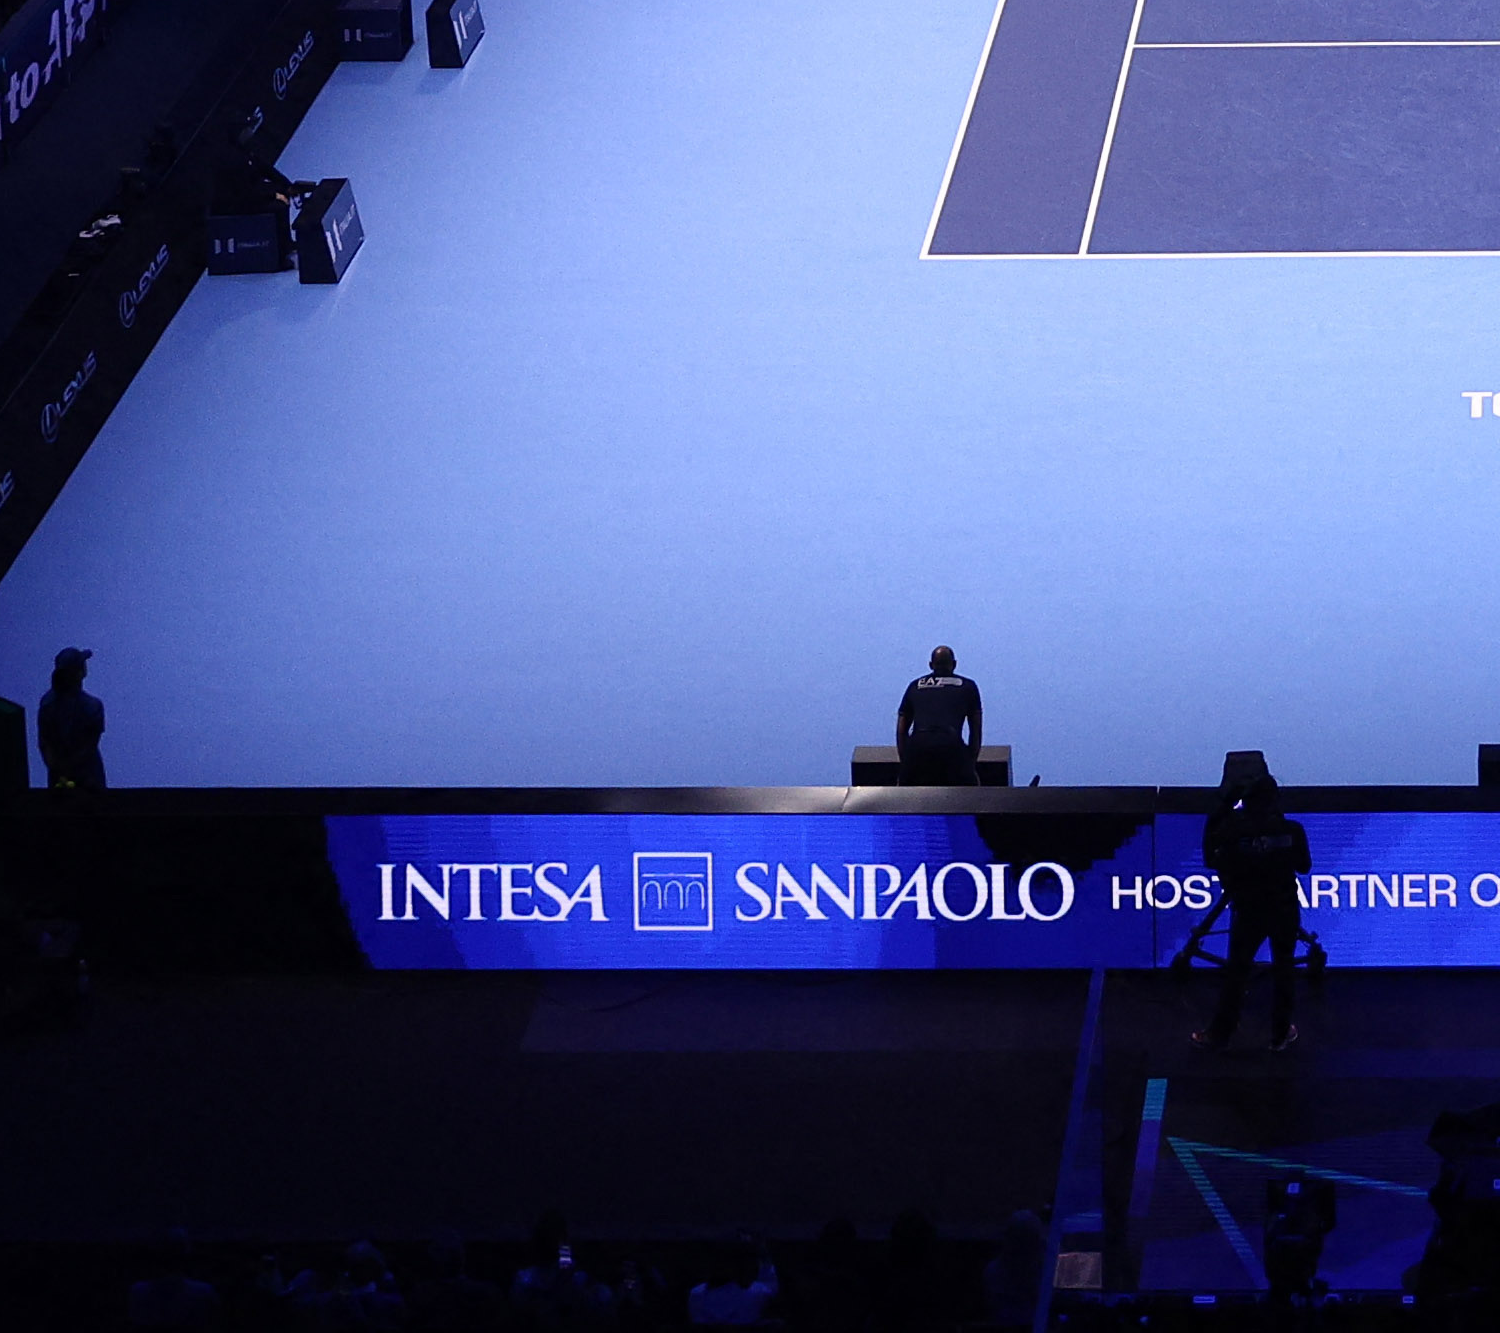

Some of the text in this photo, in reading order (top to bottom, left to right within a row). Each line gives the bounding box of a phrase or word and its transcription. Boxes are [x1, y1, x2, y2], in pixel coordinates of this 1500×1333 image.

[377, 858, 1077, 924] INTESA SANPAOLO
[1111, 874, 1228, 910] HOS
